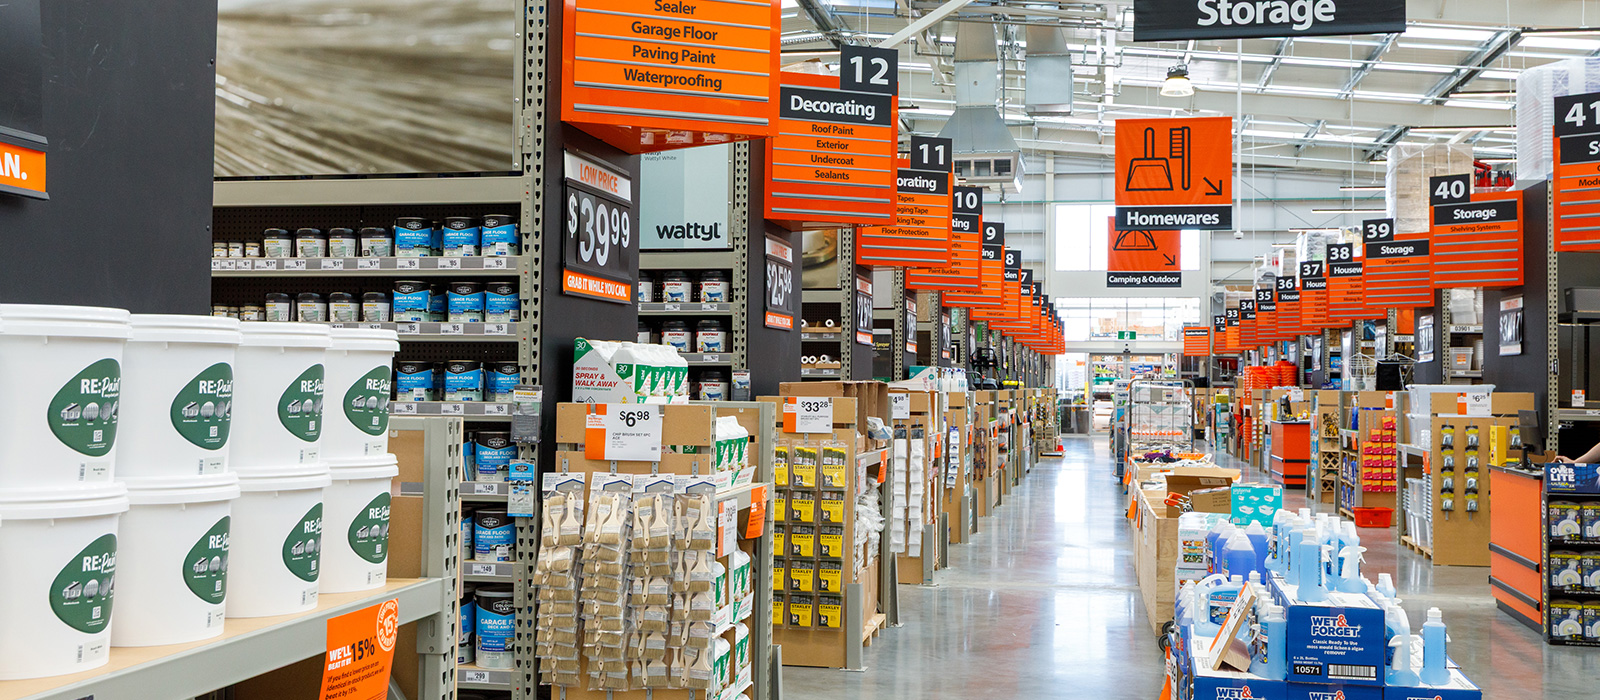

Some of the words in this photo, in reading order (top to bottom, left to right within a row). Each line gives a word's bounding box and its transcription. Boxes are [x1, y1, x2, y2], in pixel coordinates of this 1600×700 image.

[654, 0, 696, 15] Sealer
[1197, 0, 1336, 30] Storage
[631, 21, 681, 39] Garage
[684, 26, 718, 41] Floor
[633, 45, 679, 64] Paving
[682, 49, 716, 64] Paint
[850, 56, 889, 85] 12
[624, 68, 722, 91] Waterproofing
[791, 95, 875, 120] Decorating
[812, 124, 832, 133] Roof
[833, 125, 854, 135] Paint
[816, 140, 849, 150] Exterior
[811, 154, 854, 166] Undercoat
[919, 144, 944, 165] 11
[580, 164, 597, 185] LOW
[598, 170, 618, 193] PRICE
[815, 170, 850, 180] Sealants
[897, 176, 937, 191] orating
[1434, 180, 1465, 199] 40
[954, 192, 978, 209] 10
[1127, 211, 1220, 226] Homewares
[1454, 208, 1497, 221] Storage
[656, 222, 721, 241] wattyl
[986, 227, 996, 240] 9
[1367, 223, 1390, 239] 39
[1450, 225, 1475, 233] Shelving
[1330, 247, 1350, 260] 38
[1381, 246, 1414, 255] Storage
[1005, 254, 1014, 265] 8
[1303, 264, 1320, 275] 37
[1021, 272, 1028, 282] 7
[1109, 276, 1141, 284] Camping
[1278, 279, 1293, 289] 36
[567, 275, 582, 289] GRAB
[582, 278, 587, 290] IT
[588, 278, 604, 293] WHILE
[604, 282, 613, 295] YOU
[613, 283, 626, 297] CAN.
[1258, 291, 1271, 300] 35
[801, 401, 828, 412] $3328
[620, 410, 650, 427] $698
[1311, 626, 1358, 637] FORGET
[329, 645, 352, 662] WE'LL
[328, 661, 340, 671] BEAT
